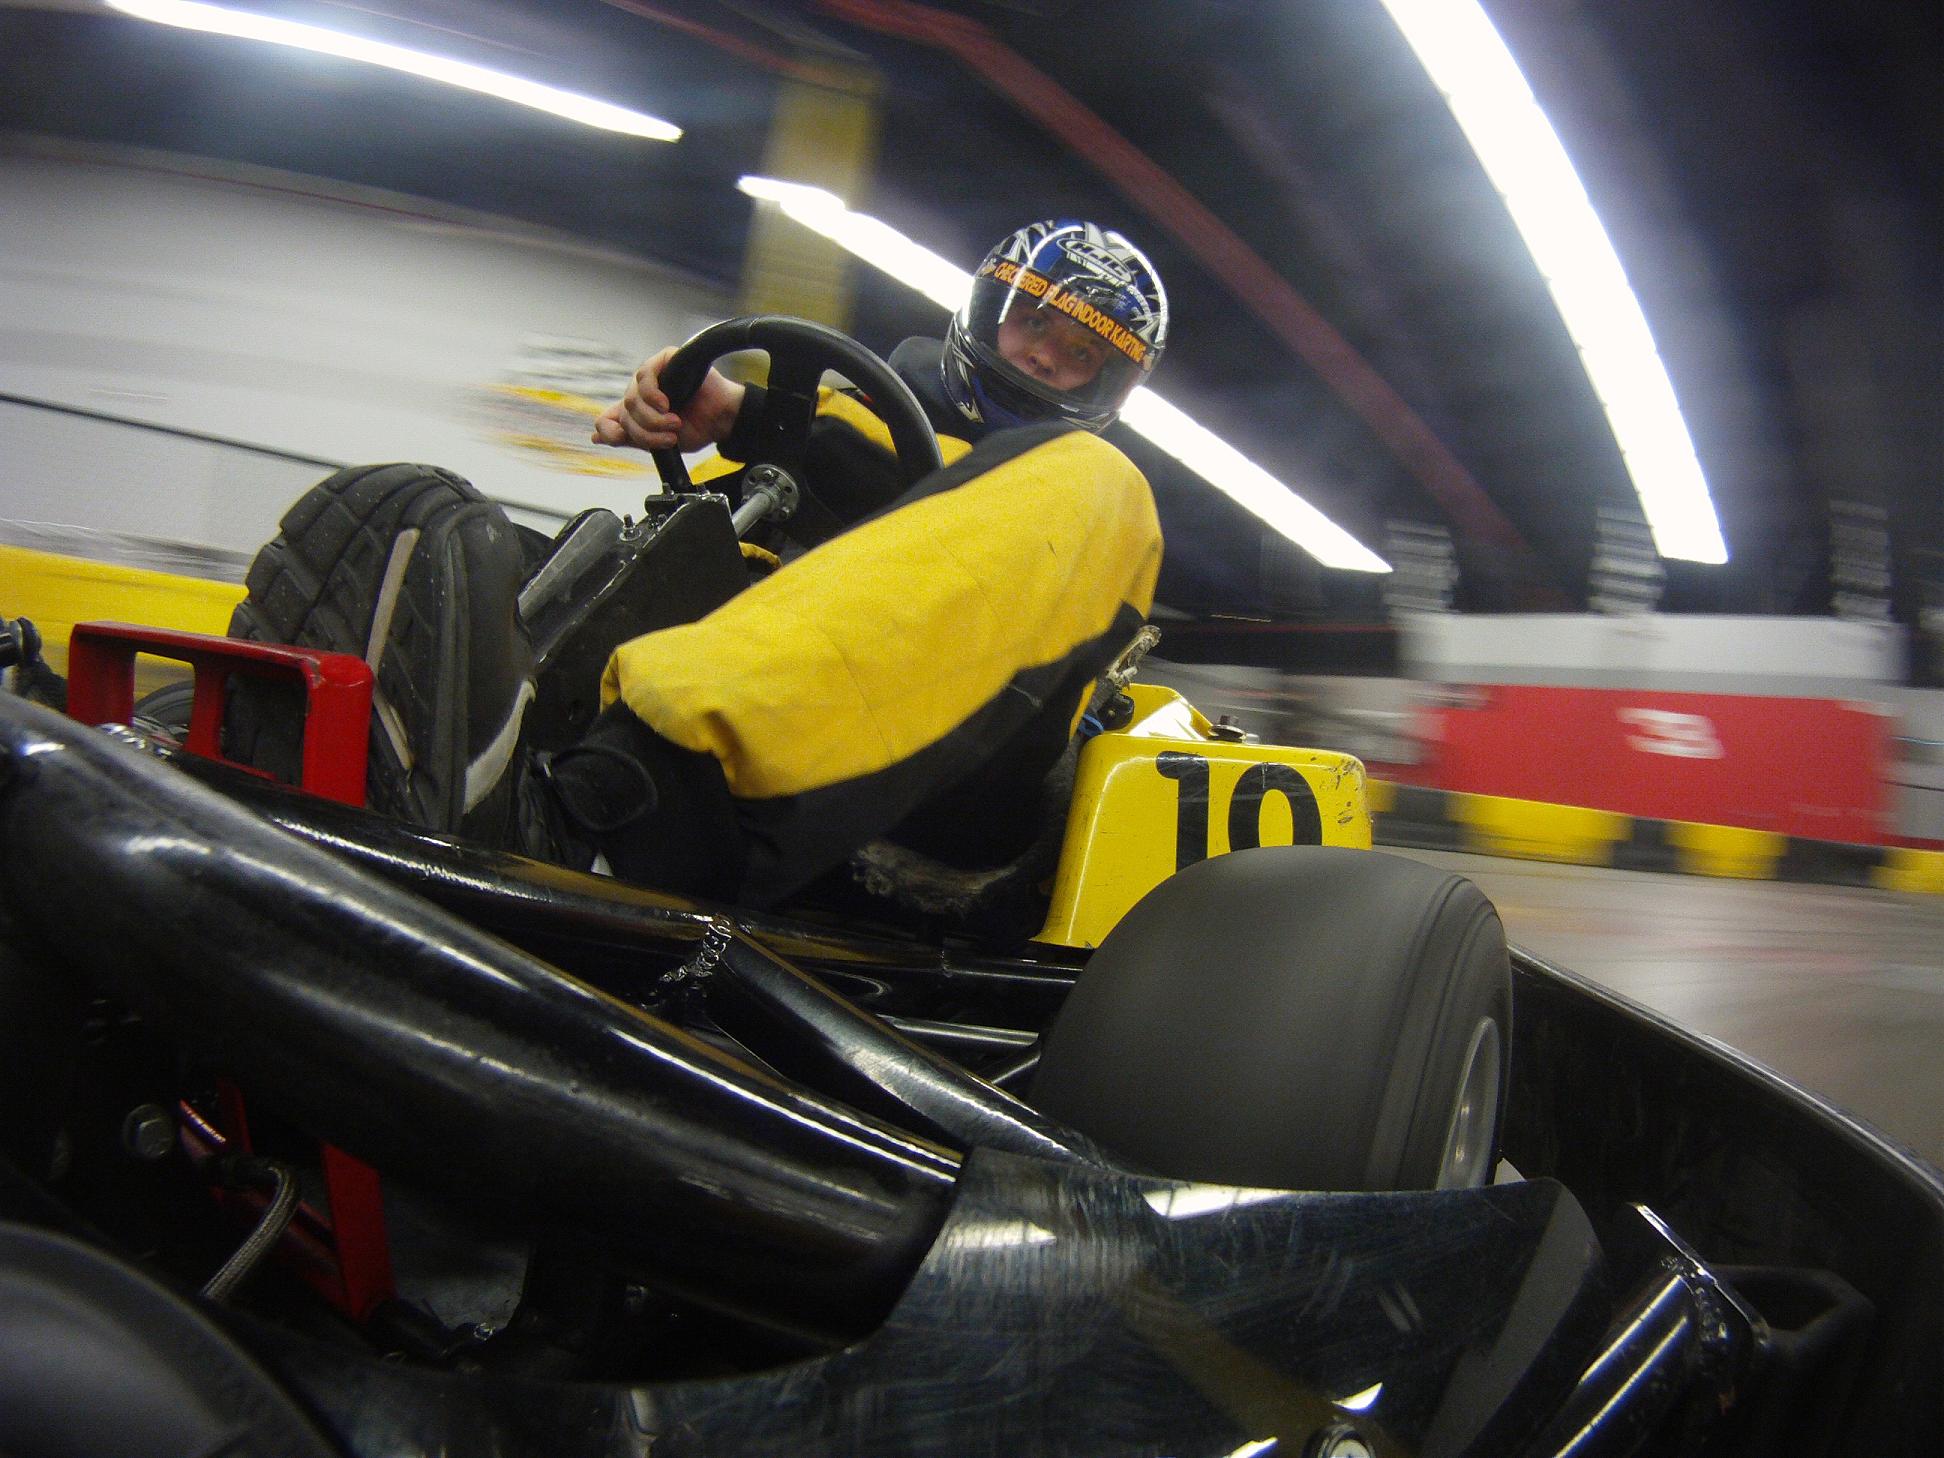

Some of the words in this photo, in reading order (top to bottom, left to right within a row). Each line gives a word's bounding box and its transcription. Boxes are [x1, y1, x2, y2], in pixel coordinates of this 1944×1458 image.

[994, 262, 1048, 297] CHECERED
[1071, 301, 1115, 338] INDOOR
[1109, 324, 1147, 362] KARTING
[1616, 707, 1725, 760] 3
[1155, 751, 1322, 873] 10
